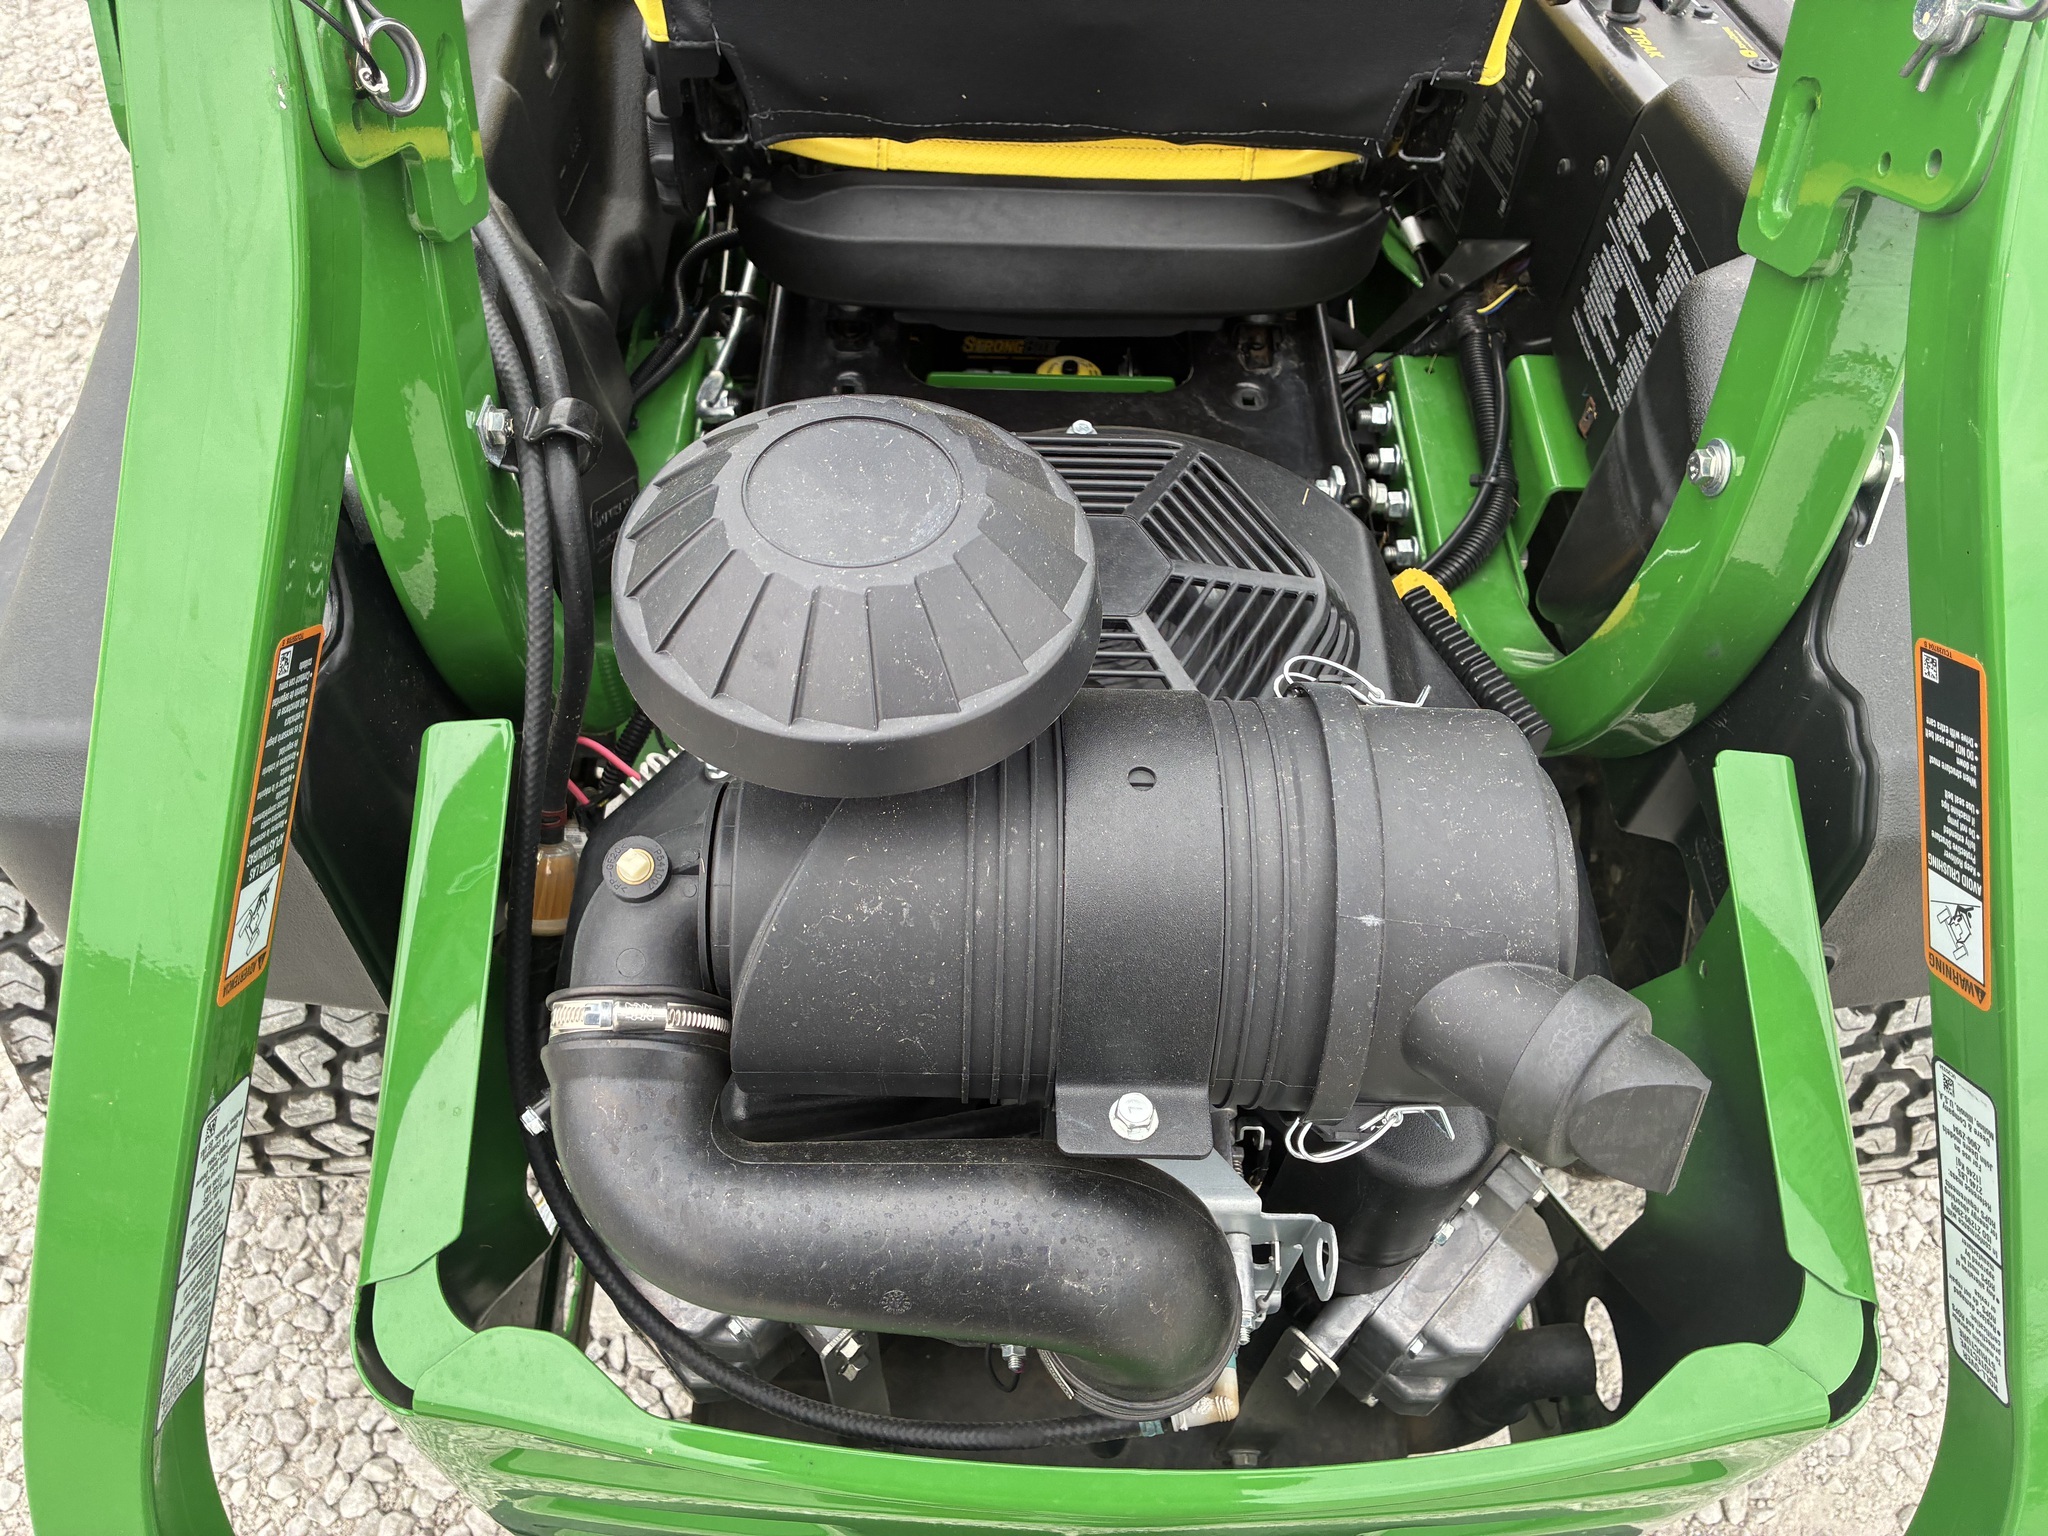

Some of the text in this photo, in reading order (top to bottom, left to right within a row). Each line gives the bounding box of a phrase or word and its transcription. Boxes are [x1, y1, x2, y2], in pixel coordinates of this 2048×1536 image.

[1624, 26, 1665, 59] ZTRAK
[1926, 714, 1936, 729] care
[1924, 727, 1934, 741] belt
[1934, 732, 1944, 746] seat
[1945, 737, 1953, 750] use
[1949, 727, 1959, 740] with
[1960, 732, 1973, 748] Drive
[1955, 742, 1965, 756] NOT
[1929, 754, 1976, 788] When structure must
[1956, 756, 1968, 772] down
[1944, 788, 1974, 814] Use seat belt
[1946, 812, 1959, 830] jump
[1950, 804, 1970, 824] machine
[1943, 823, 1963, 845] extended
[246, 833, 284, 866] APLASTADURAS
[1931, 828, 1975, 864] Protective Structure
[248, 852, 276, 881] EVITAR LAS
[1928, 851, 1981, 897] AVOID CRUSHING
[1964, 860, 1975, 876] Keep
[222, 960, 256, 996] ADVERTENCIA
[1929, 951, 1973, 996] WARNING
[1942, 1101, 1966, 1127] Company
[1973, 1126, 1989, 1147] Deere
[1942, 1124, 1992, 1172] John Deere models
[1961, 1148, 1971, 1163] use
[1972, 1158, 1981, 1172] For
[1944, 1185, 1969, 1214] absorbing
[1964, 1182, 1991, 1212] Reference
[1970, 1208, 1988, 1230] energy
[1980, 1209, 1995, 1229] ROPS
[1982, 1229, 1991, 1244] ISO
[1967, 1259, 1979, 1276] must
[1972, 1254, 1994, 1281] approved
[1948, 1271, 1962, 1290] repair
[1980, 1272, 1994, 1291] ROPS
[1986, 1285, 1995, 1301] Any
[1952, 1302, 1964, 1321] ROPS
[1953, 1285, 1996, 1333] Replace damaged
[1965, 1317, 1974, 1331] and
[1958, 1328, 1995, 1370] STRUCTURE
[1960, 1338, 1997, 1382] PROTECTIVE
[1963, 1351, 1997, 1392] ROLL-OVER
